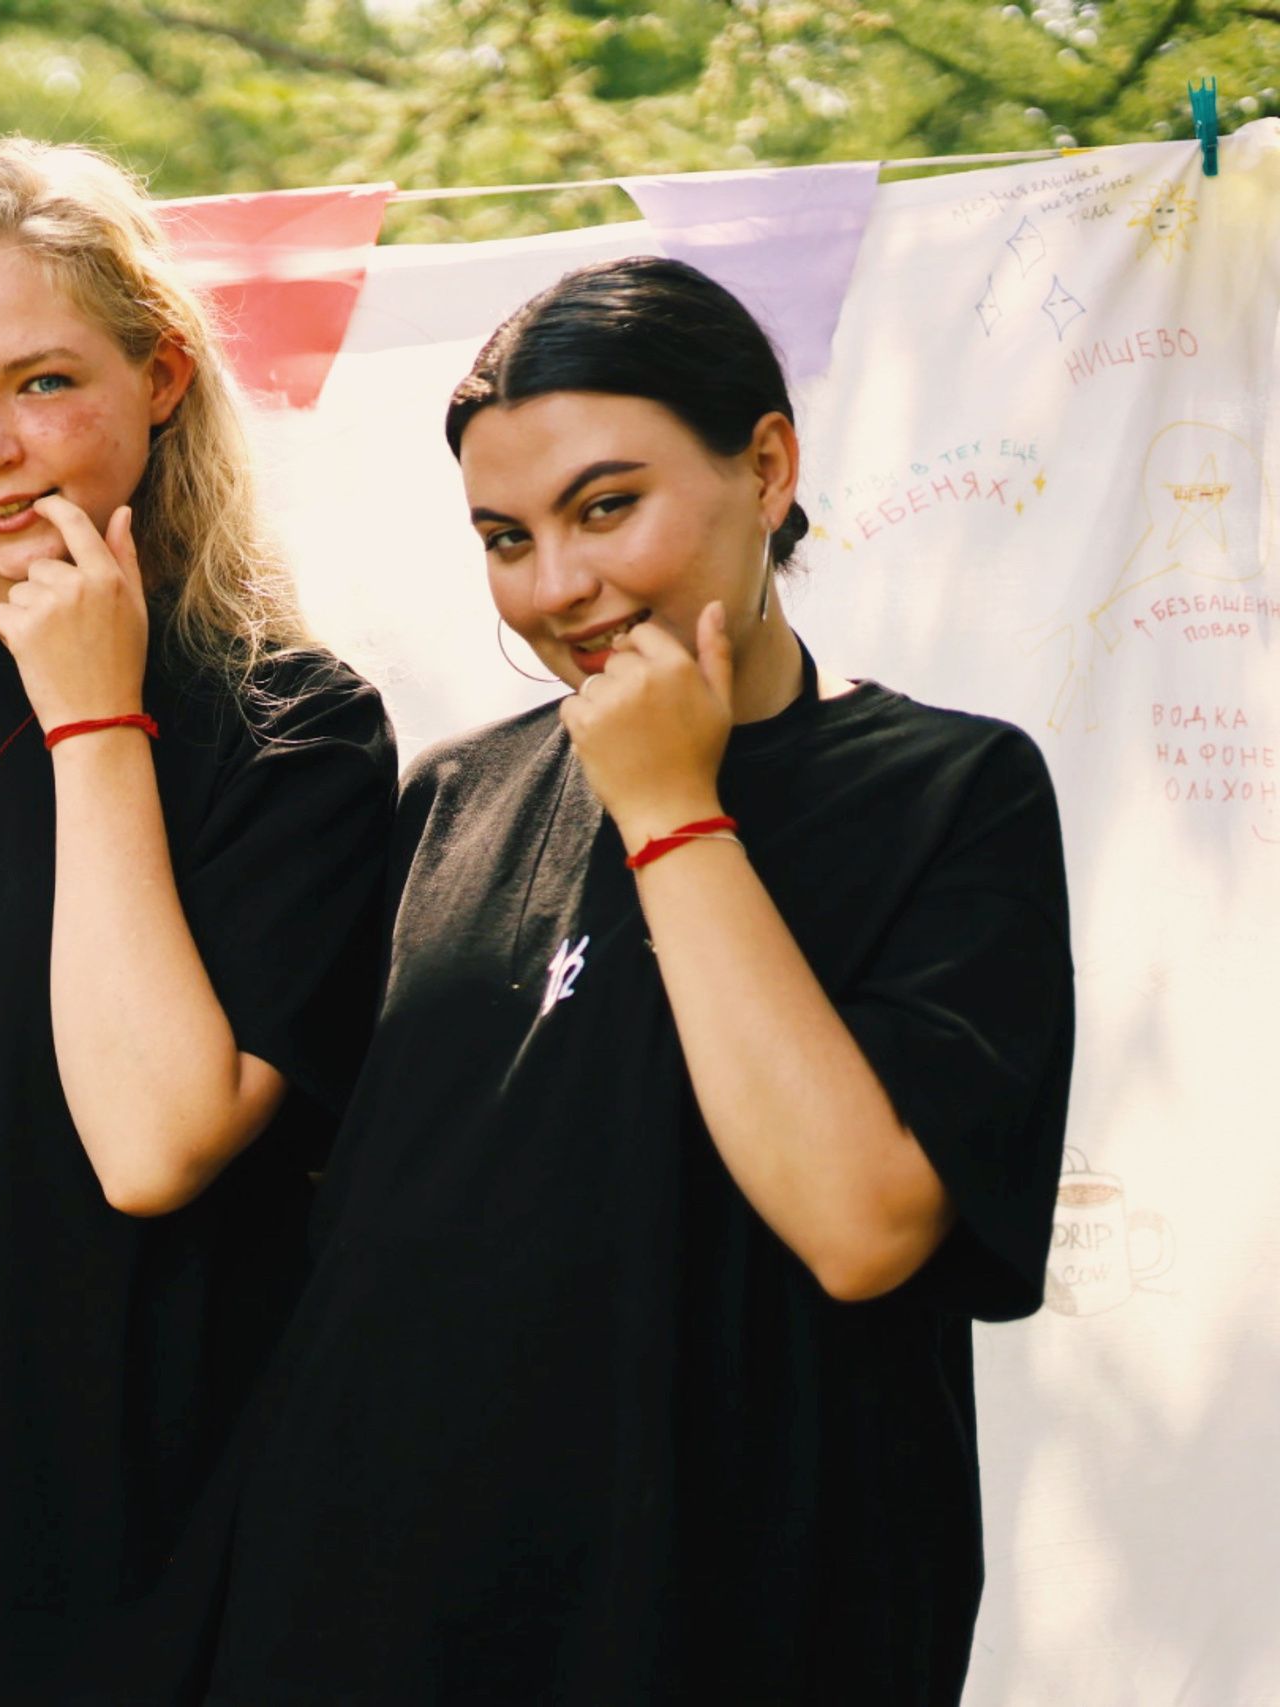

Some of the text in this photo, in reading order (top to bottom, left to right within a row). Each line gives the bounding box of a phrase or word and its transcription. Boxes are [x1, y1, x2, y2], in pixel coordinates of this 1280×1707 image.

[1063, 327, 1199, 386] НИШЕВО
[937, 440, 982, 464] ТЕХ
[854, 470, 1010, 540] ЕБЕНЯХ
[1183, 622, 1251, 644] ПОВАР
[1151, 703, 1249, 732] ВОДКА
[1156, 742, 1275, 768] НА ФОНЕ
[1164, 776, 1277, 804] ОЛЬХОН
